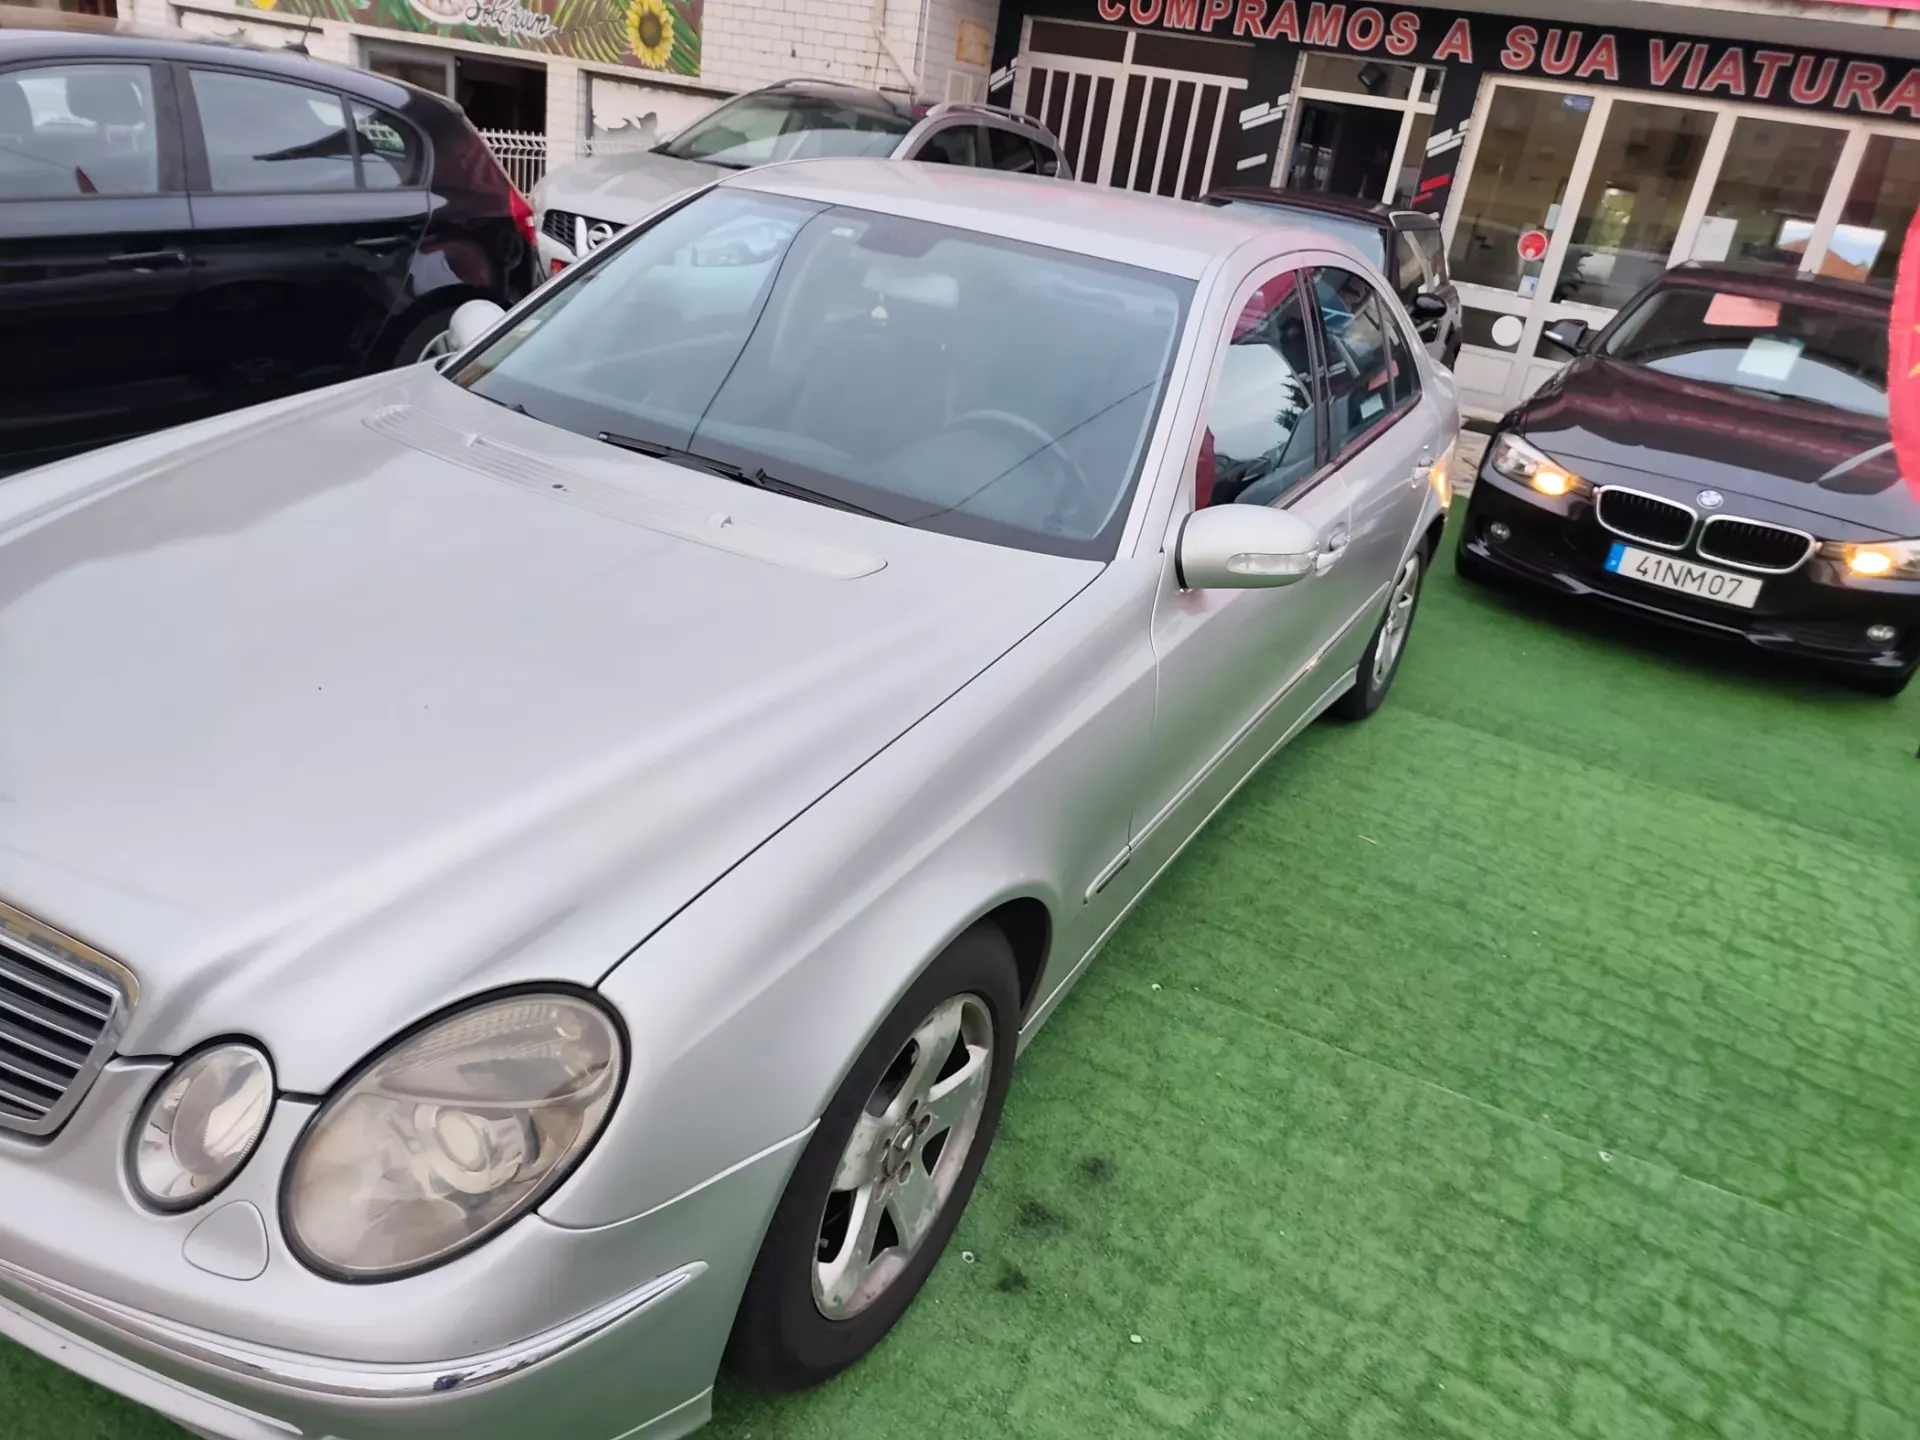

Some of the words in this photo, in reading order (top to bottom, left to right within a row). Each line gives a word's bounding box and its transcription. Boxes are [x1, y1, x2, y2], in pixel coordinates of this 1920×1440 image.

[1432, 18, 1473, 64] A
[1500, 25, 1620, 81] SUA
[1648, 38, 1920, 118] VIATURA
[1635, 555, 1743, 600] 41NM07
